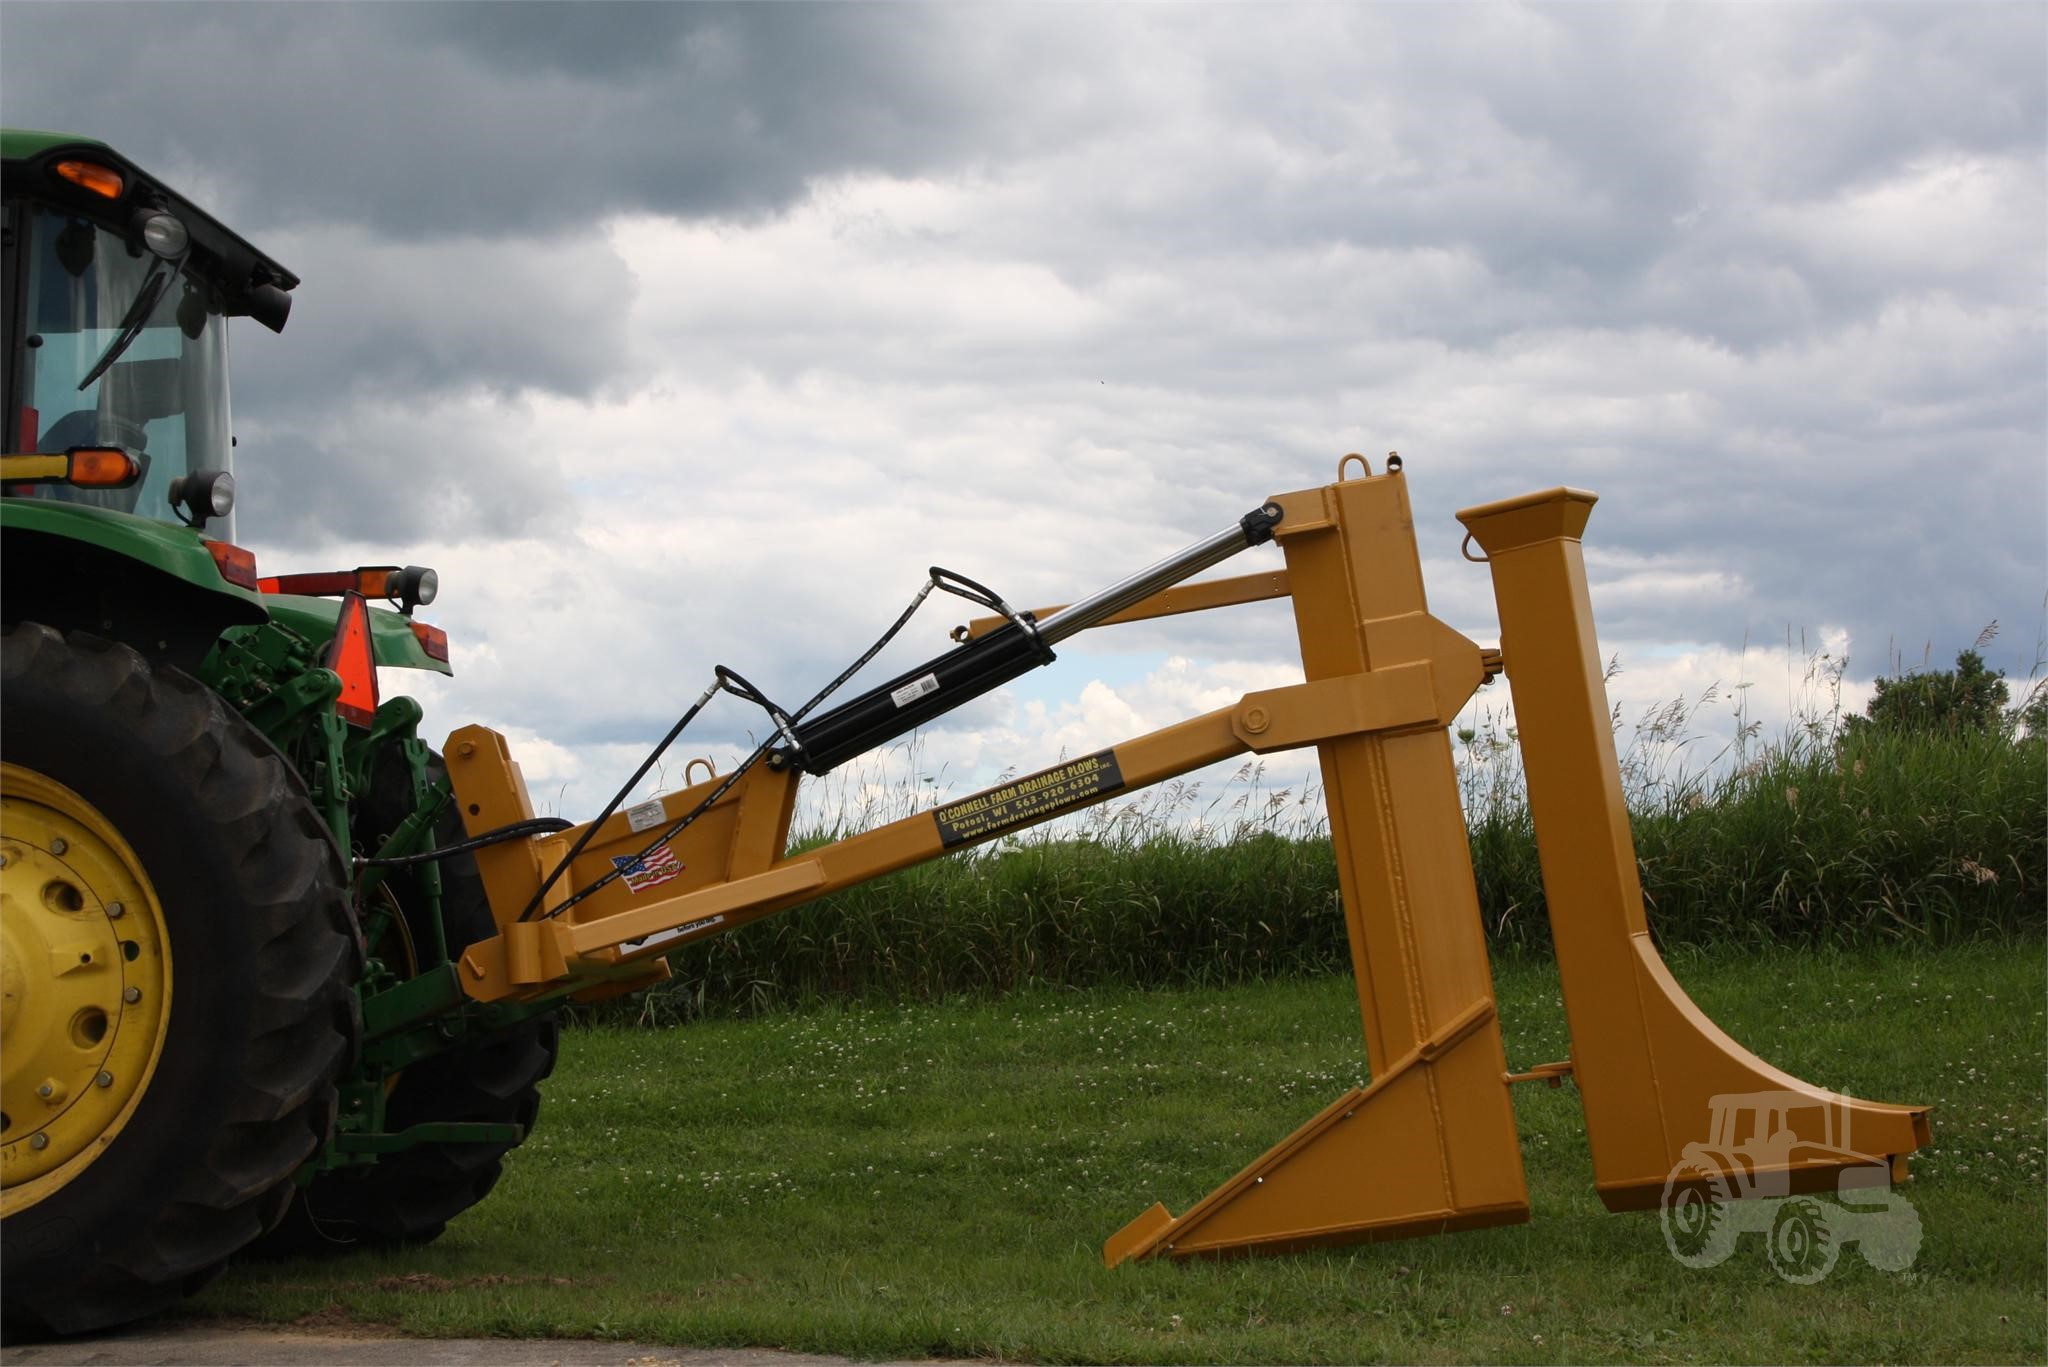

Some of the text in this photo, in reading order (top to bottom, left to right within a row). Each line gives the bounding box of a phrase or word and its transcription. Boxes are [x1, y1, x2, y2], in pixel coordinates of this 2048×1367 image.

[939, 797, 990, 823] O'CONNELL
[990, 786, 1017, 805] FARM
[1017, 769, 1066, 795] DRAINAGE
[1067, 758, 1099, 777] PLOWS
[952, 773, 1099, 832] Potosi, WI 563-920-6304
[962, 786, 1099, 839] www.farmdrainageplows.com
